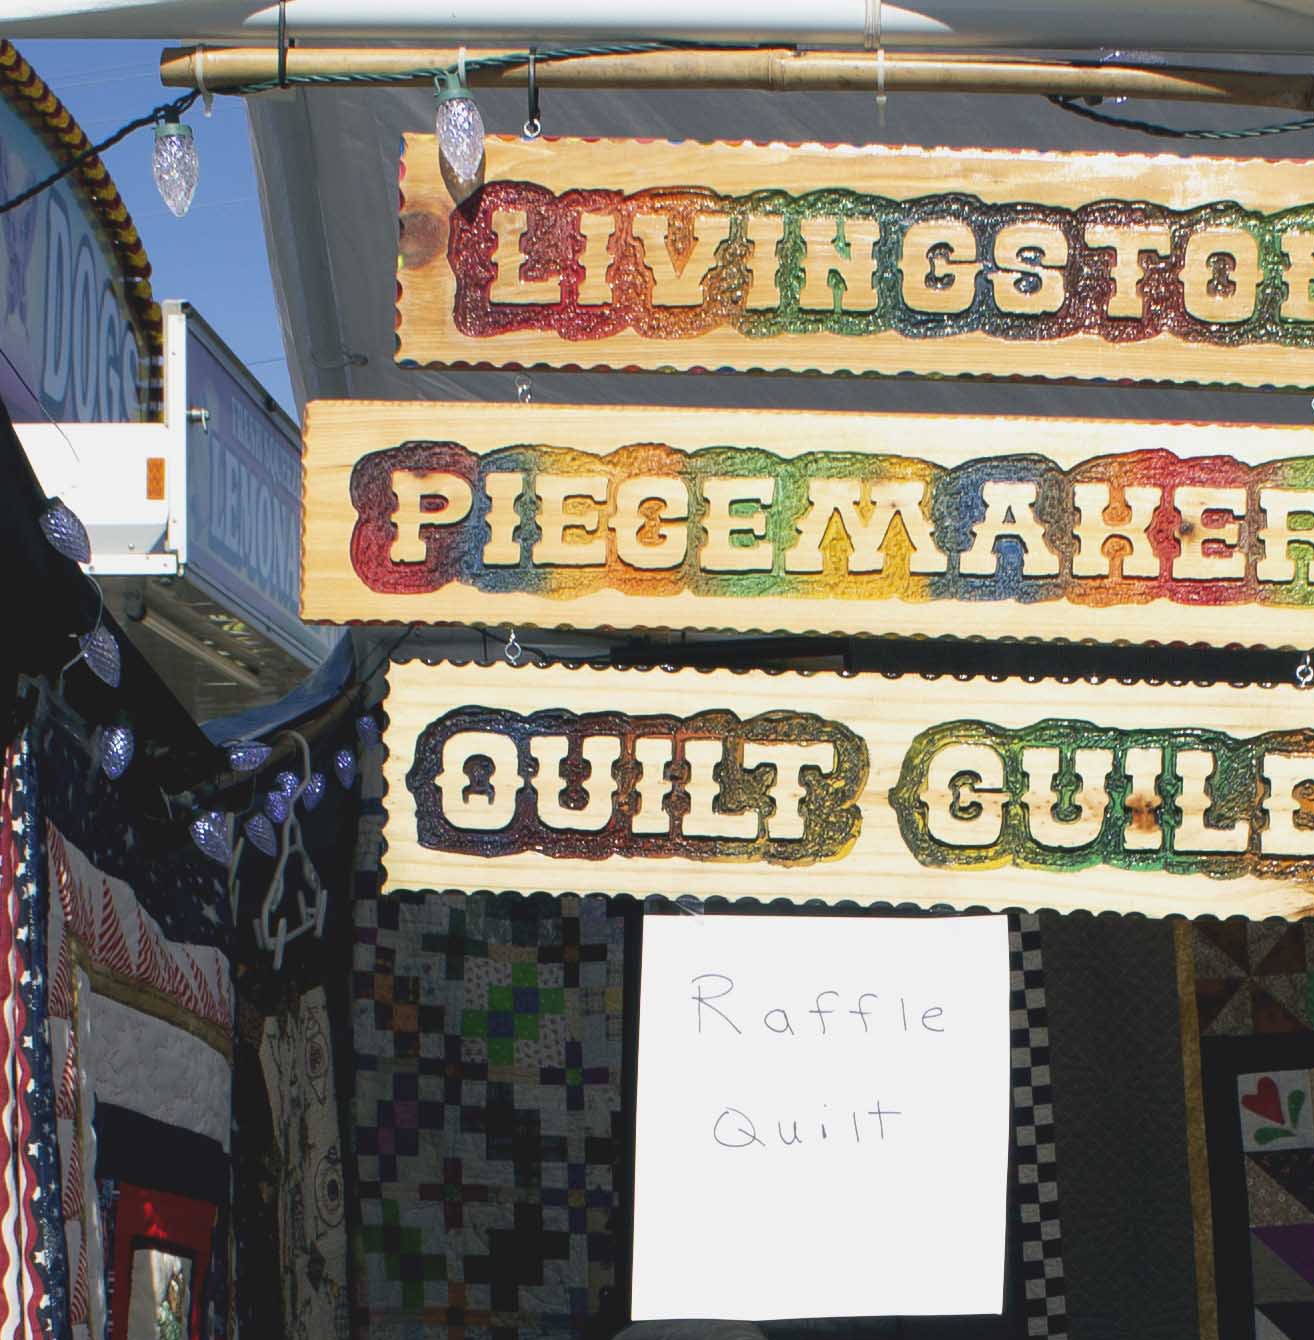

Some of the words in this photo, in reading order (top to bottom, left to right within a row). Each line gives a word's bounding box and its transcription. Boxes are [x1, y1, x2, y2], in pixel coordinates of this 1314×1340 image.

[435, 727, 837, 840] QUILT
[690, 973, 946, 1036] Raffle
[712, 1099, 903, 1148] Quilt
